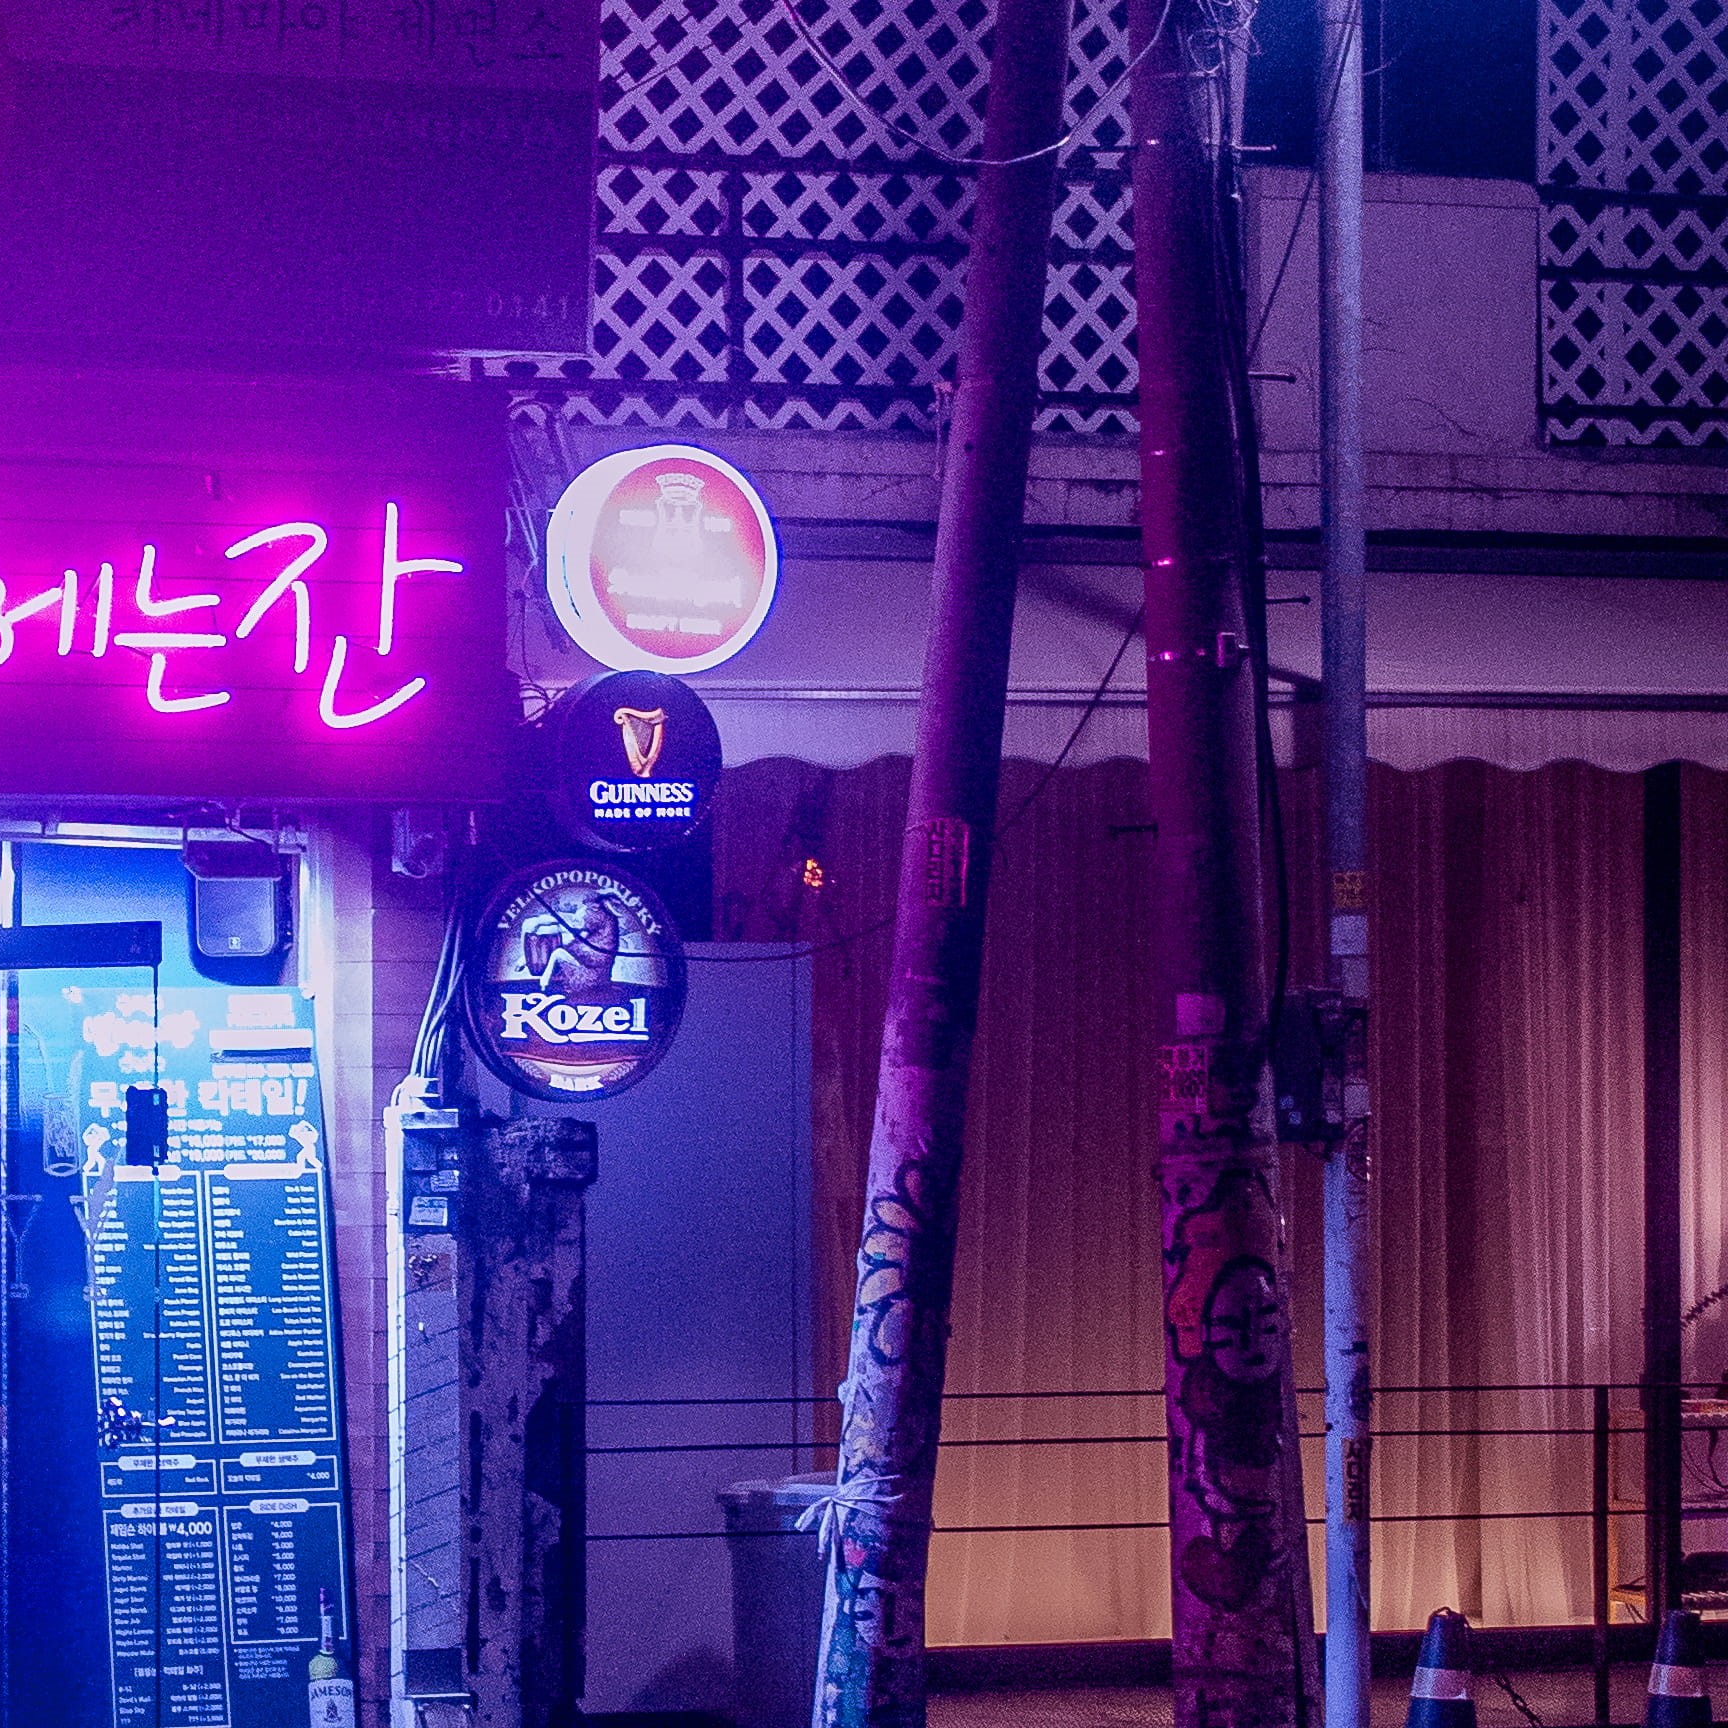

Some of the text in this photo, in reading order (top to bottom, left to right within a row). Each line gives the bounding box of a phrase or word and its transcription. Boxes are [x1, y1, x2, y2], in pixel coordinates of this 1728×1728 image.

[589, 780, 694, 805] GUINNESS
[594, 807, 691, 818] MADE OF MORE
[500, 992, 650, 1043] Kozel
[88, 1079, 189, 1118] 무한
